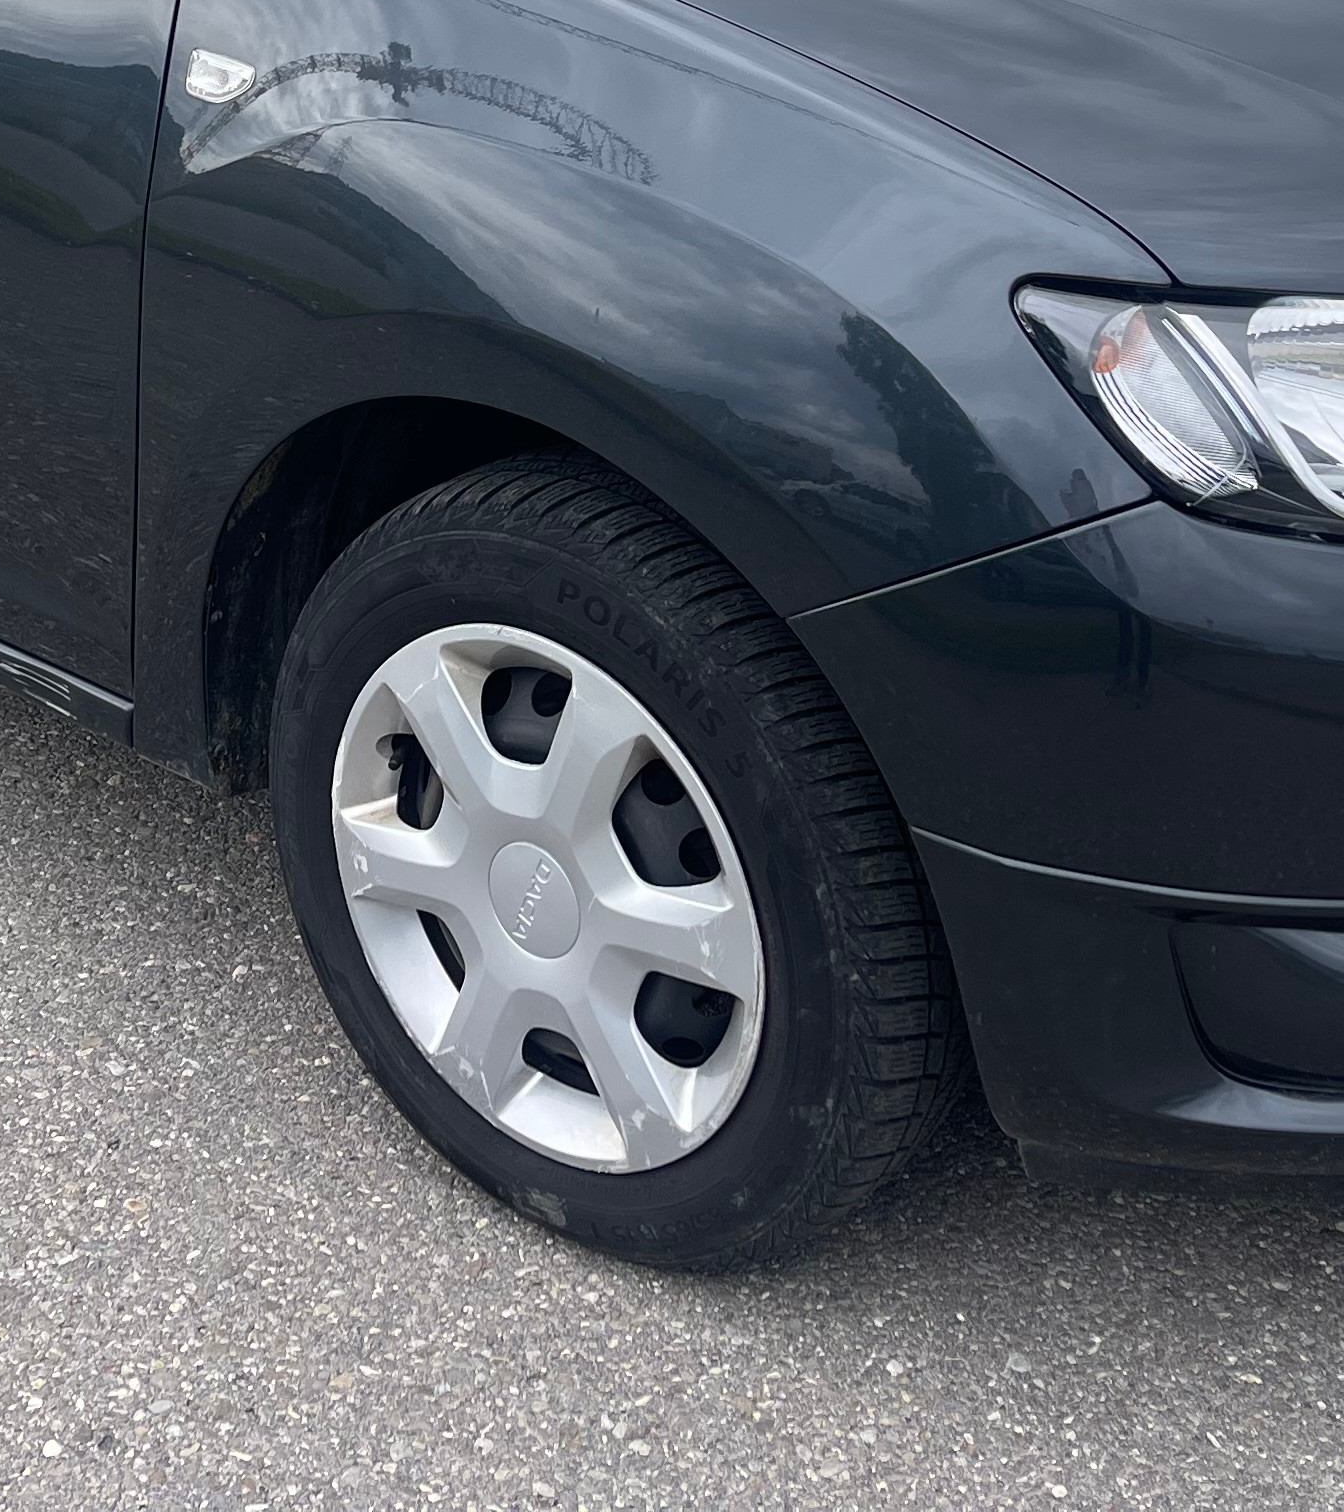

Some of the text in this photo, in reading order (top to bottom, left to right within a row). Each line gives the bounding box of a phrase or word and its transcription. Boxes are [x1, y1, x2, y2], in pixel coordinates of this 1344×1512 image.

[557, 577, 755, 779] POLARIS 5
[511, 857, 552, 940] DACIA
